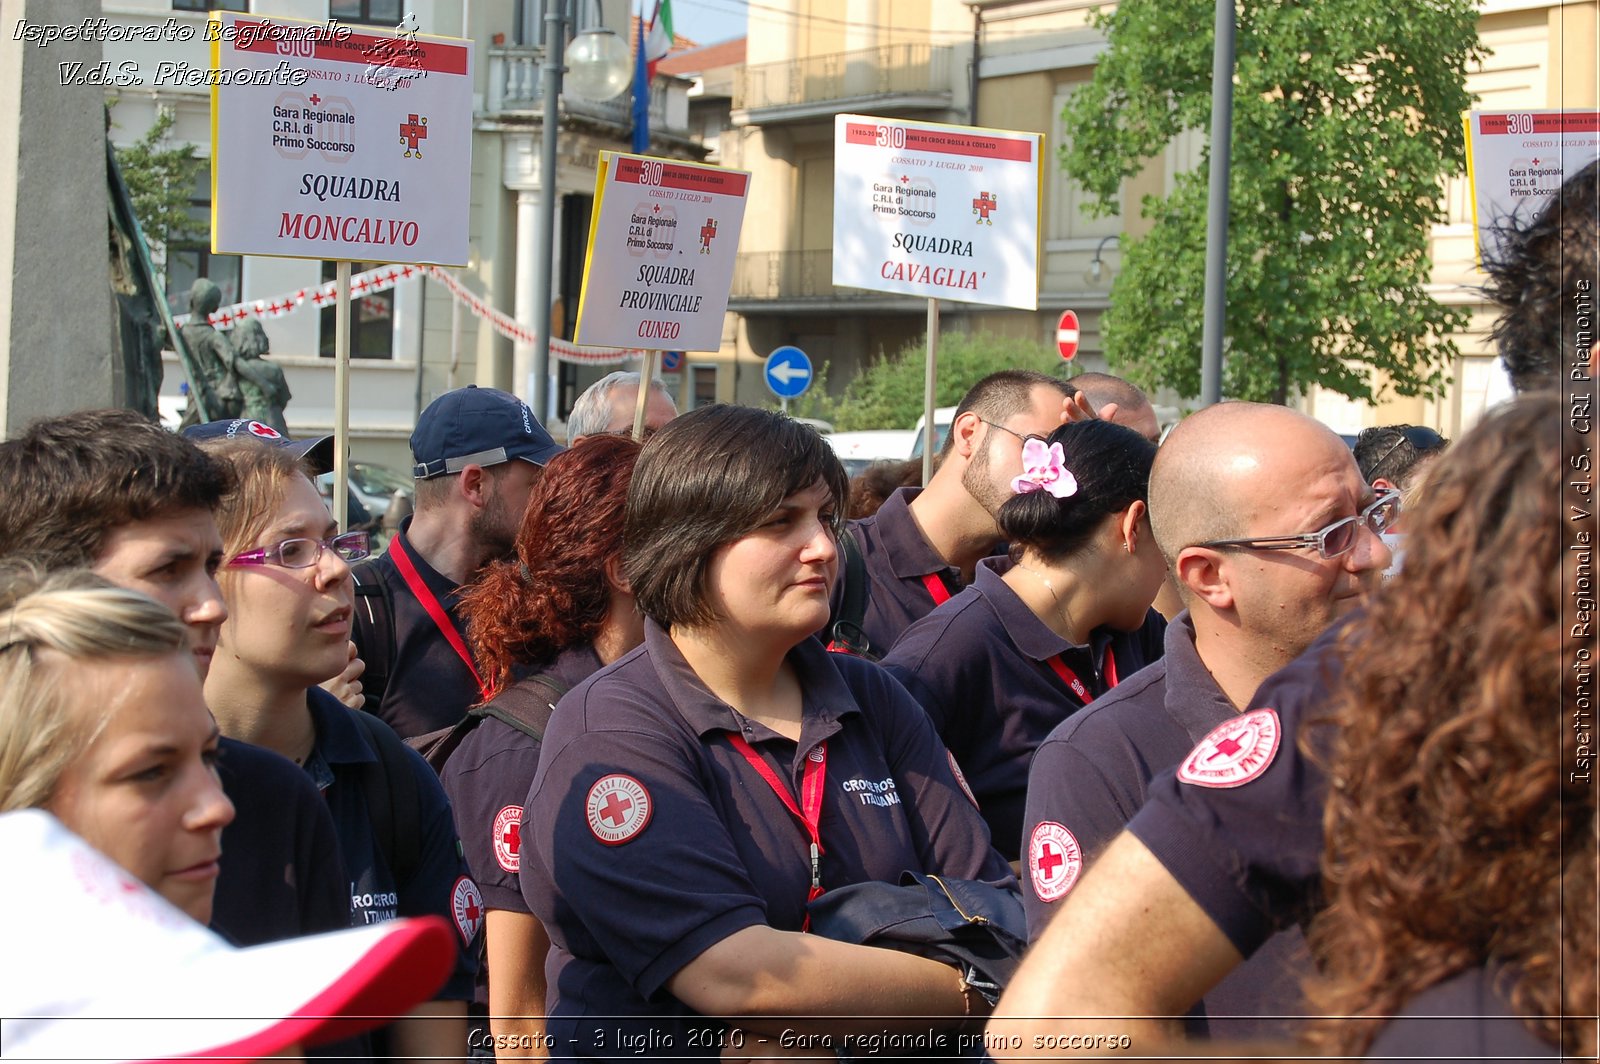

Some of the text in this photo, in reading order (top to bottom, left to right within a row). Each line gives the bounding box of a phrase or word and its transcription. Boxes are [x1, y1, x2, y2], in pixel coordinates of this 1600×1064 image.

[344, 74, 351, 82] 3
[273, 105, 355, 124] Gara Regionale
[1506, 113, 1534, 134] 30
[273, 120, 313, 135] C.R.I. di
[272, 134, 355, 153] Primo Soccorso
[876, 124, 906, 150] 30
[928, 136, 947, 145] CROCE
[947, 137, 965, 146] ROSSA
[966, 139, 971, 147] A
[972, 139, 997, 150] COSSATO
[639, 161, 663, 186] 30
[892, 156, 984, 173] COSSATO 3 LUGLIO 2010
[1509, 168, 1527, 177] Gara
[300, 173, 401, 203] SQUADRA
[873, 183, 937, 199] Gara Regionale
[1509, 179, 1529, 187] C.R.I.
[873, 194, 904, 205] C.R.I. di
[631, 213, 677, 229] Gara Regionale
[872, 204, 936, 220] Primo Soccorso
[278, 212, 420, 247] MONCALVO
[629, 226, 653, 237] C.R.I. di
[626, 237, 674, 251] Primo Soccorso
[892, 232, 974, 258] SQUADRA
[637, 264, 696, 287] SQUADRA
[881, 260, 986, 290] CAVAGLIA'
[619, 290, 703, 313] PROVINCIALE
[637, 319, 680, 340] CUNEO
[872, 777, 896, 793] ROS
